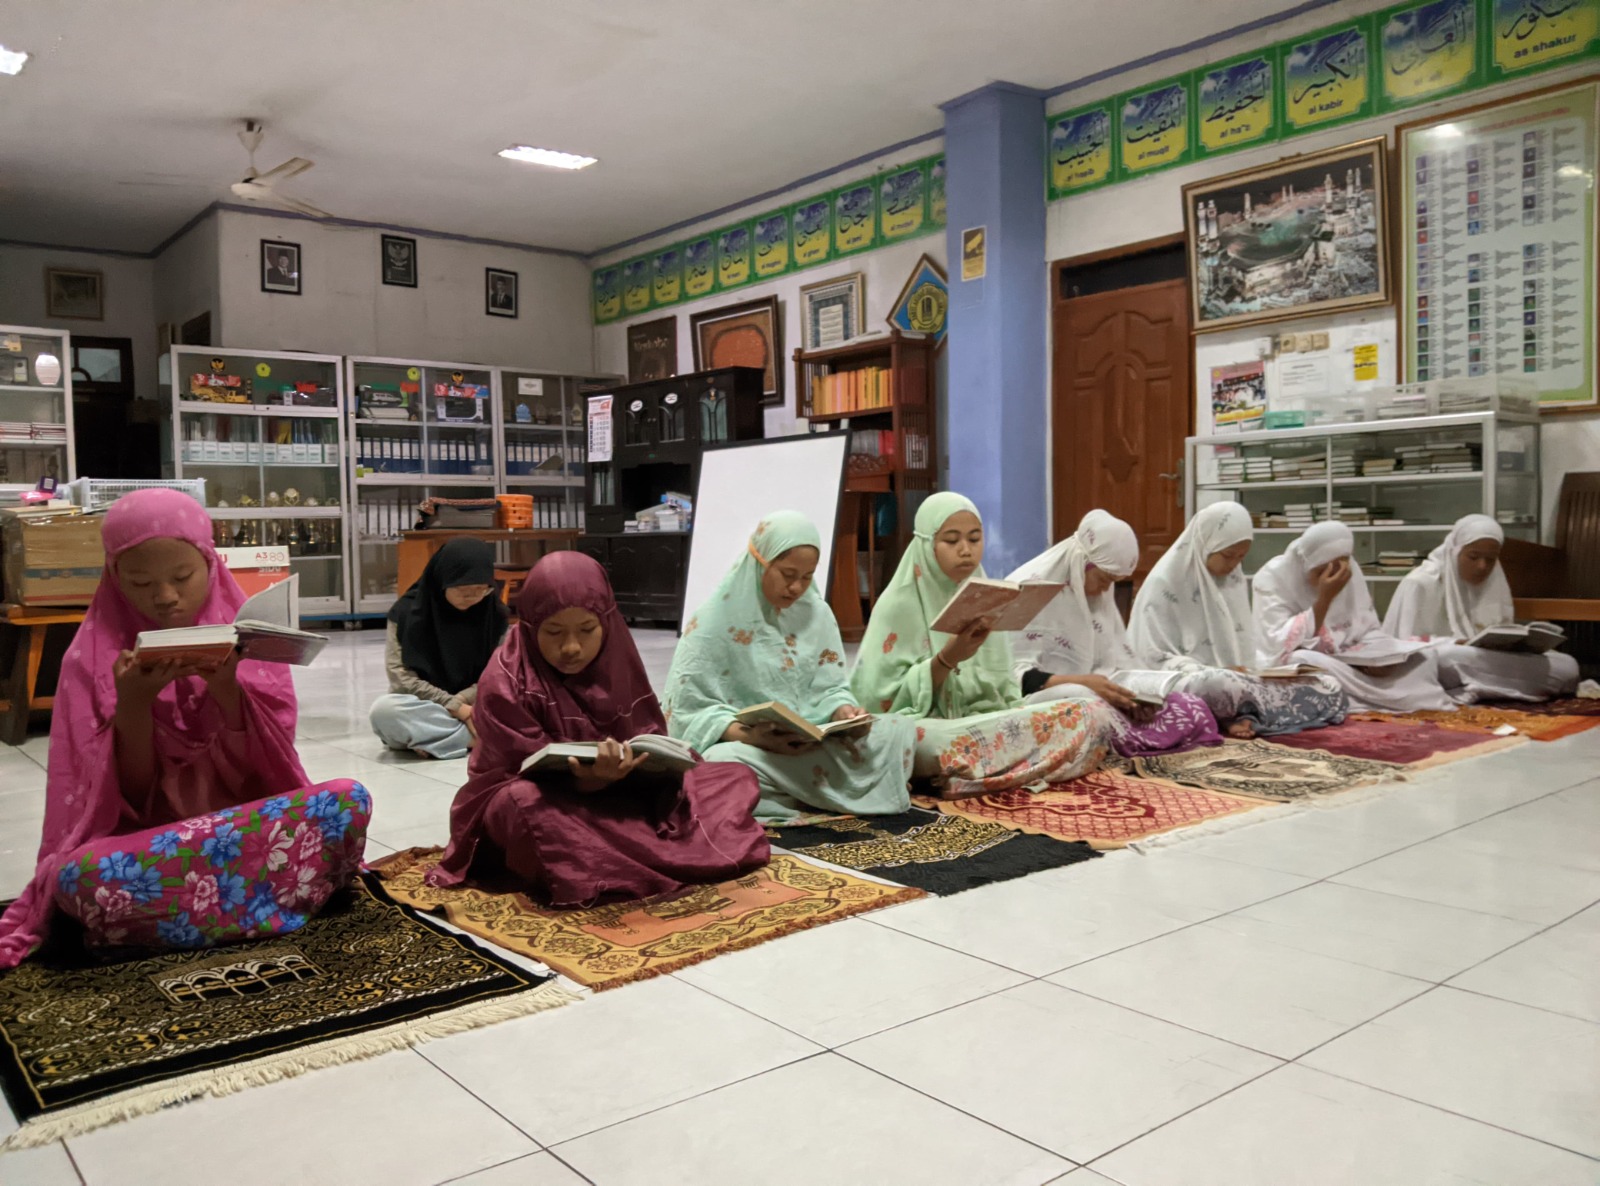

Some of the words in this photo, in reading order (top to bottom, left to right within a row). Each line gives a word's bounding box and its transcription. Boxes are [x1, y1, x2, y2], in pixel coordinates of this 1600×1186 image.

[1513, 47, 1529, 59] as
[1532, 33, 1578, 53] shakur
[1308, 105, 1317, 115] al
[1318, 99, 1344, 112] kabir
[256, 551, 268, 559] A3
